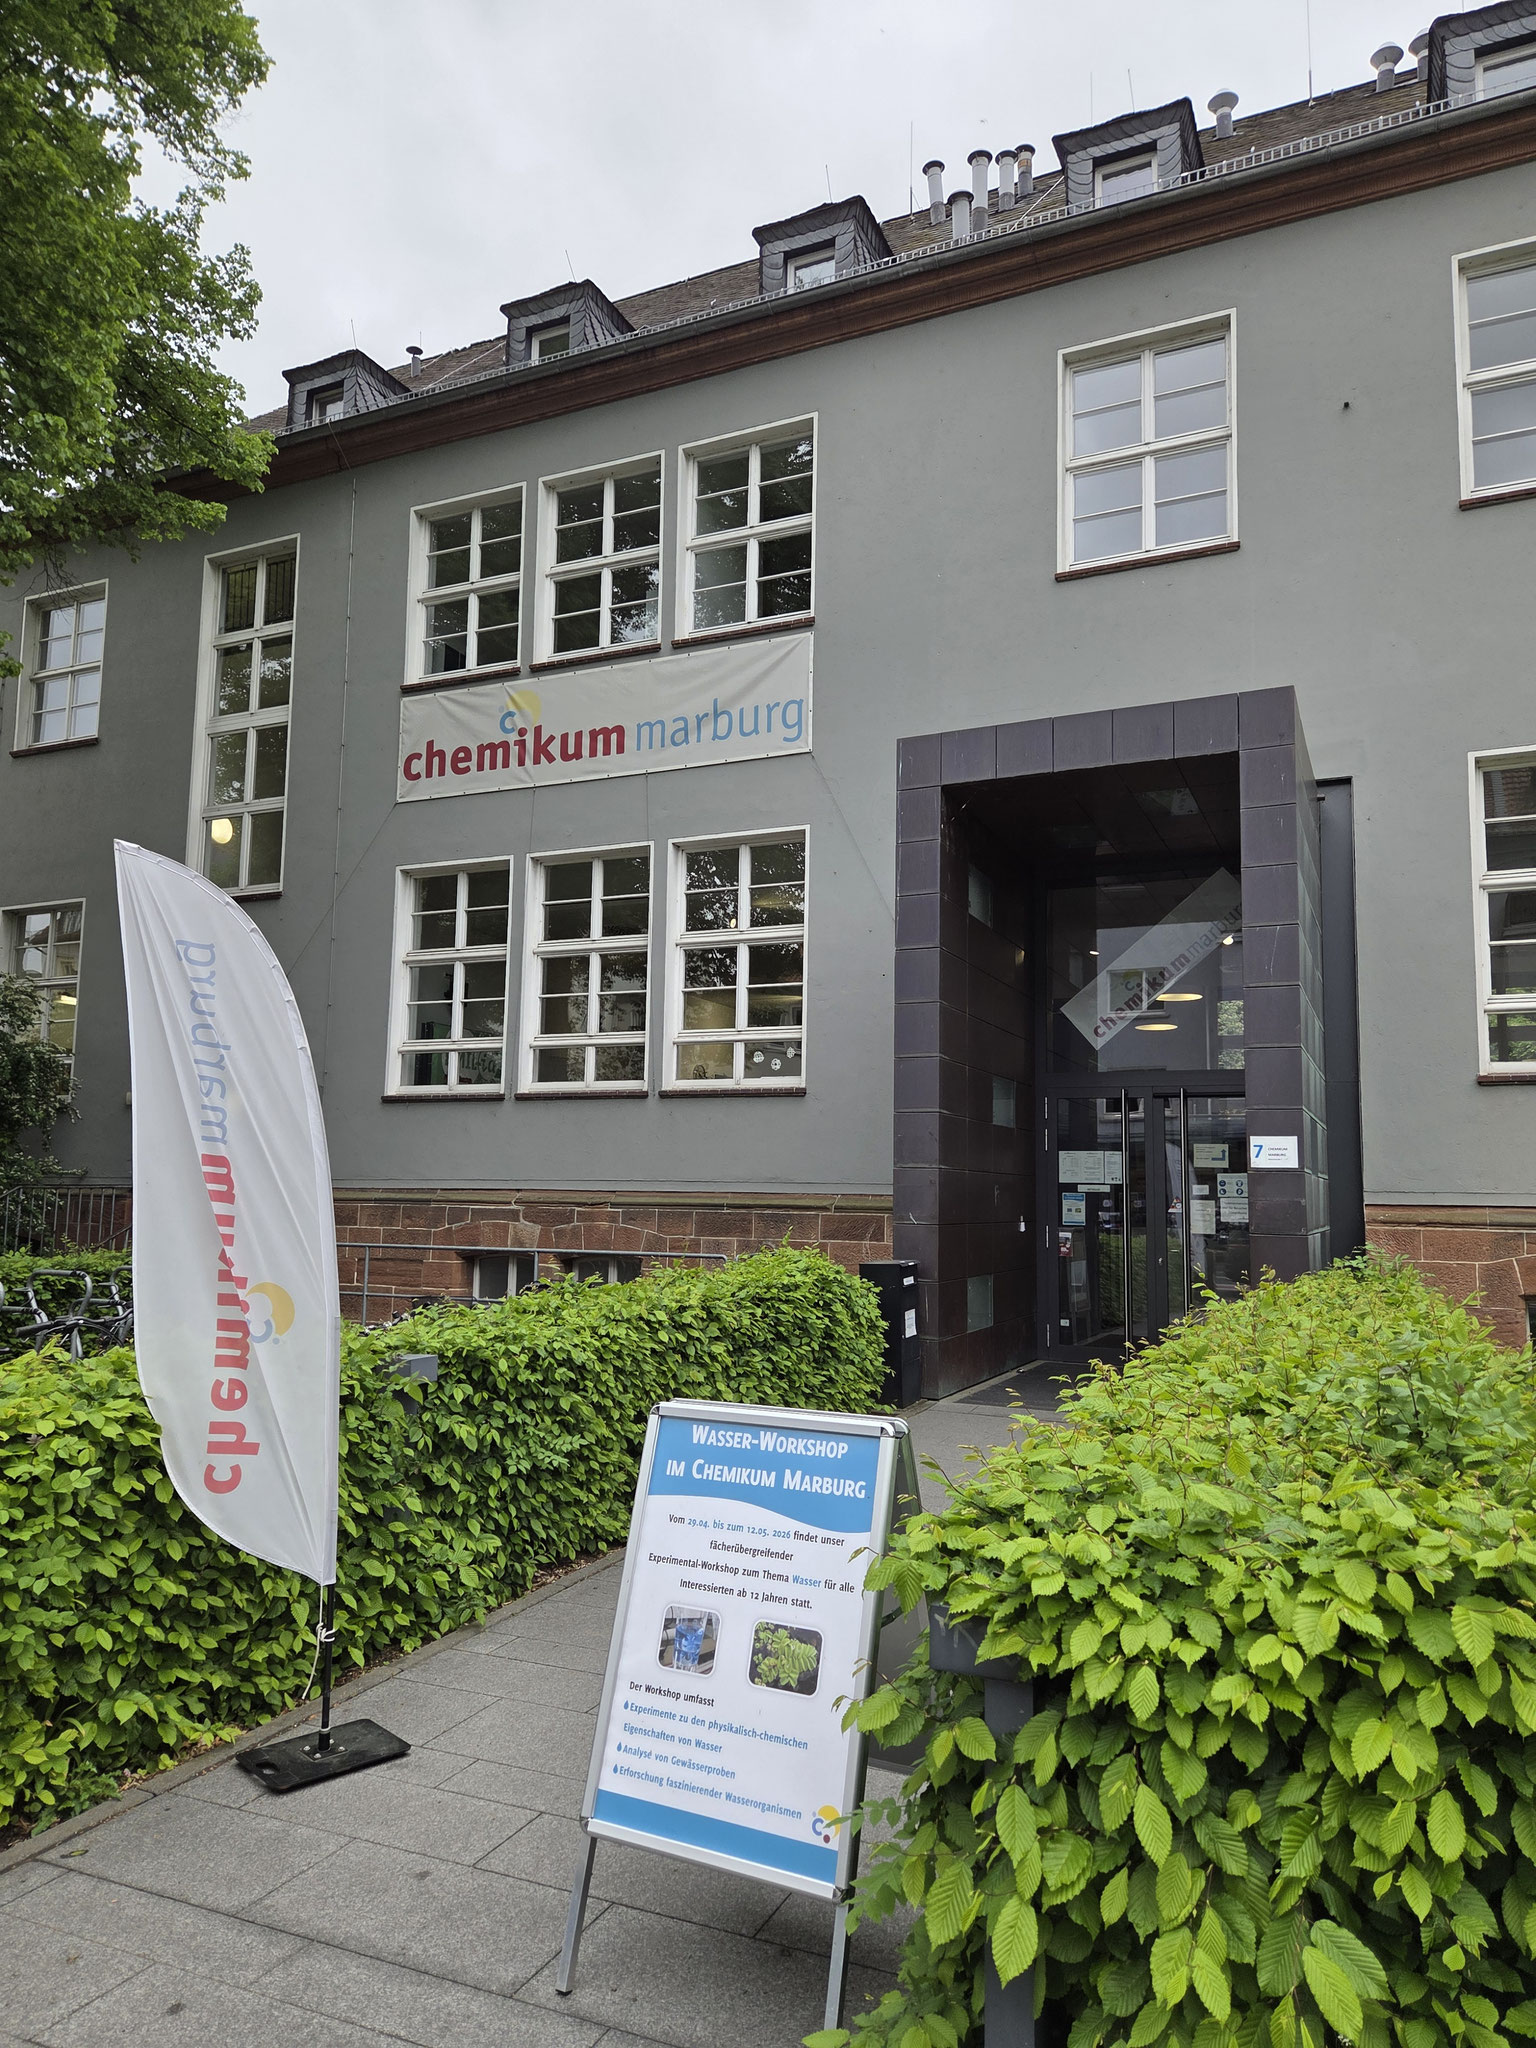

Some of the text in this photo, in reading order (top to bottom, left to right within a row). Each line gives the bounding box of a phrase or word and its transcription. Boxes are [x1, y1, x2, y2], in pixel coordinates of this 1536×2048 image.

[402, 698, 805, 782] chemikum marburg
[1253, 1144, 1263, 1158] 7
[668, 1514, 845, 1547] Vom 29.04. bis zum 12.05. 2026 findet unser
[709, 1540, 794, 1561] fächerübergreifender
[648, 1552, 855, 1594] Experimental-Workshop zum Thema Wasser für alle
[679, 1579, 813, 1609] Interessierten ab 12 Jahren statt.
[629, 1681, 715, 1707] Der Workshop umfasst
[623, 1722, 722, 1754] Eigenschaften von Wasser
[629, 1702, 809, 1751] Experimente zu den physikalisch-chemischen
[622, 1744, 736, 1780] Analyse von Gewässerproben
[619, 1765, 802, 1820] Erforschung faszinierender Wasserorganismen
